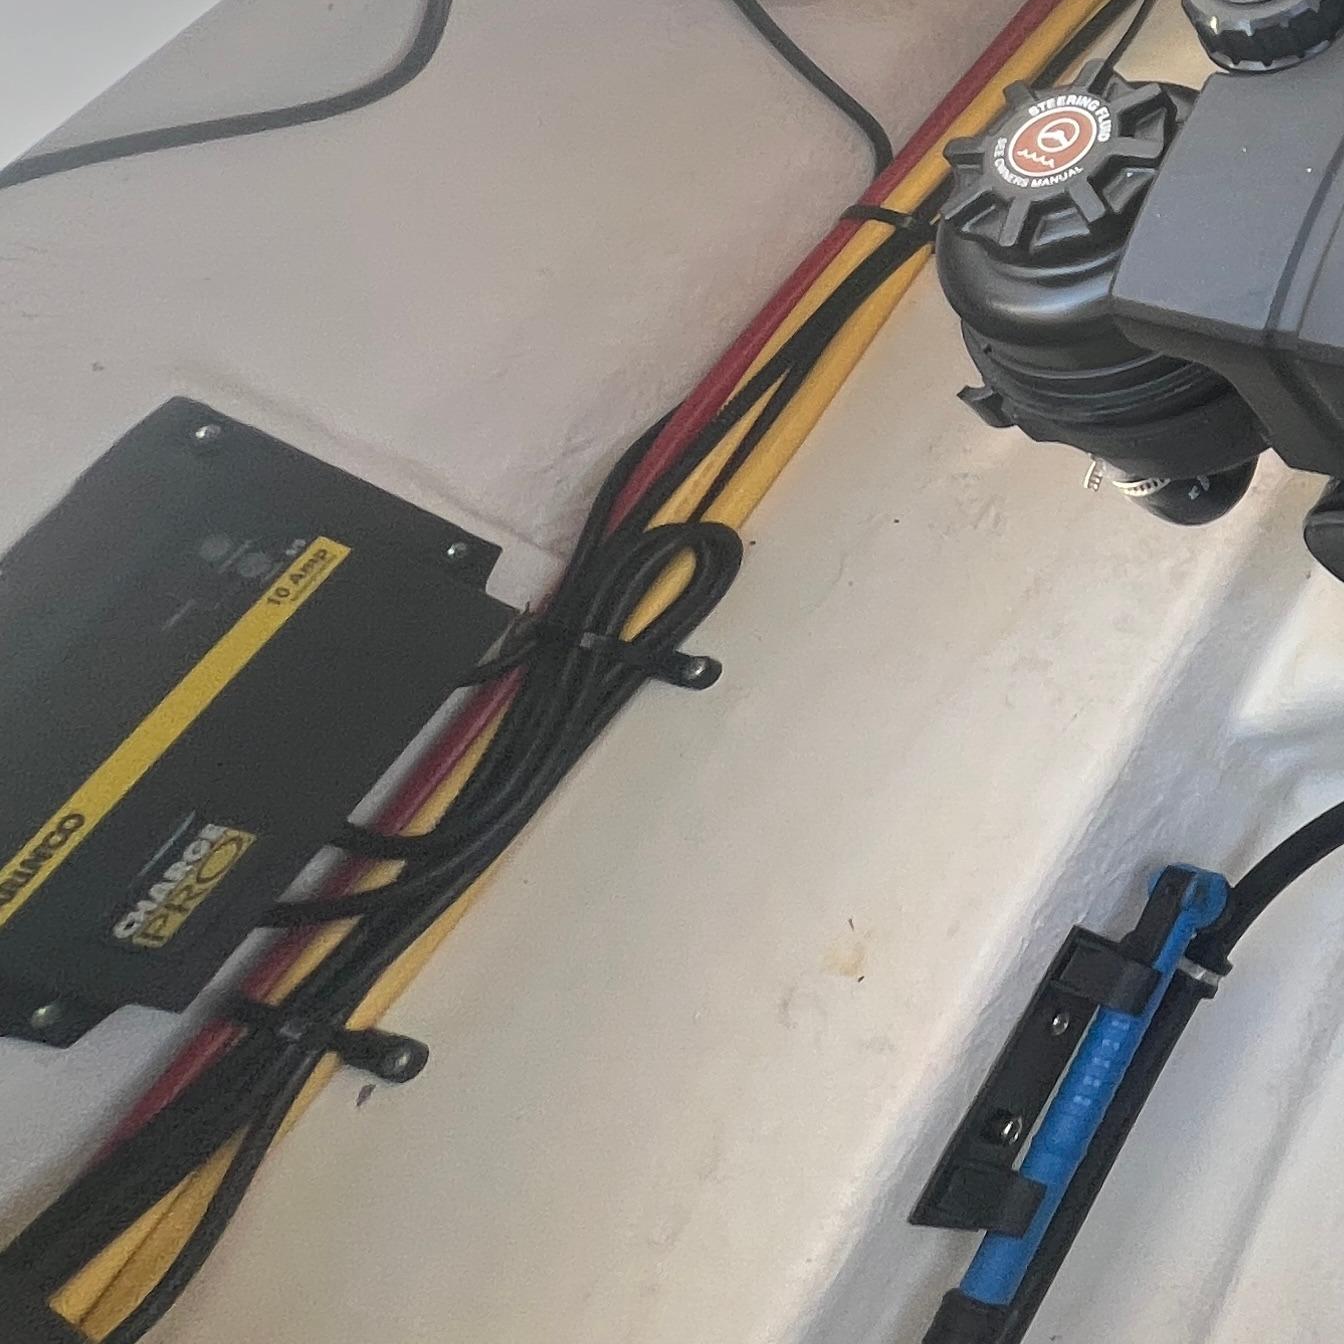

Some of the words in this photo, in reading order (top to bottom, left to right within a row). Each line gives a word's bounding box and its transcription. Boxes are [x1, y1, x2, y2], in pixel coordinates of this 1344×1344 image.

[1028, 95, 1100, 116] STEERING
[1095, 106, 1112, 142] FLUID
[1031, 166, 1084, 187] MANUAL
[268, 586, 291, 605] 10
[113, 824, 228, 939] CHARGE
[138, 836, 244, 941] PRO
